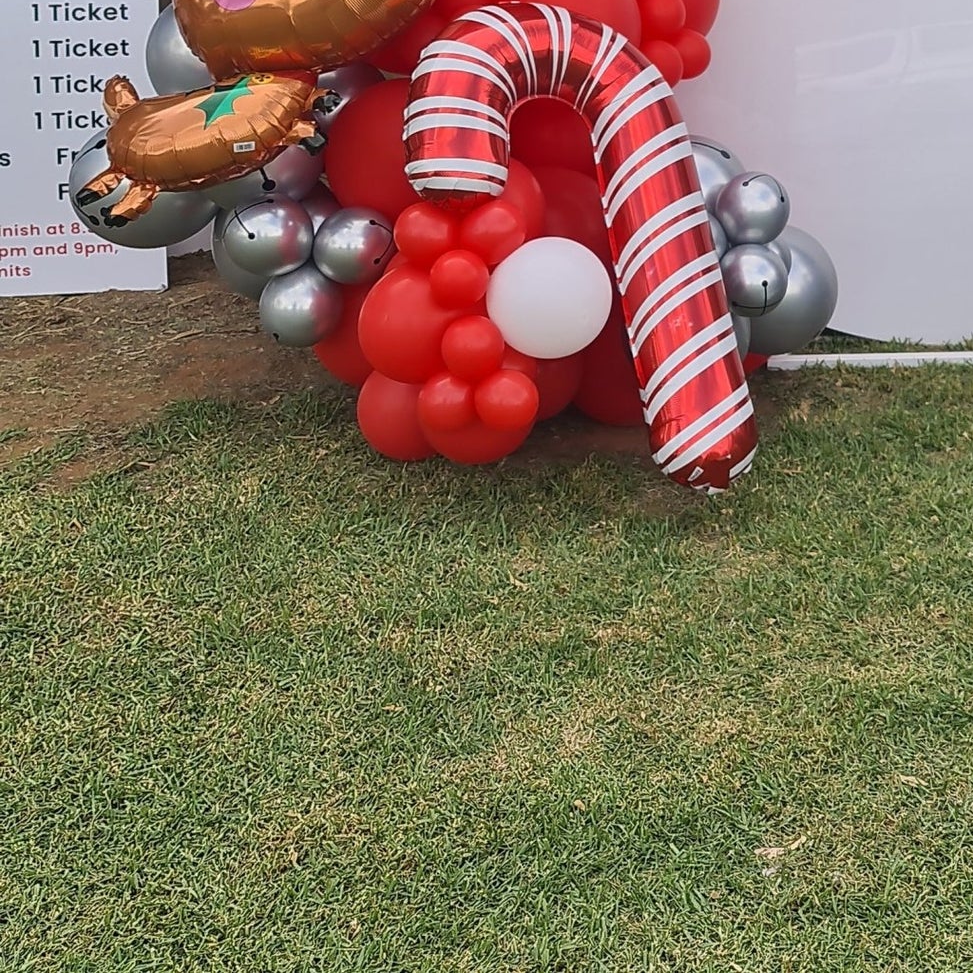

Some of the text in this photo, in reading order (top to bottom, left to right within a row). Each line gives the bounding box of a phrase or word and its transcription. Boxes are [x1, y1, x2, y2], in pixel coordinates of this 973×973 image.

[31, 2, 129, 22] 1 Ticket
[32, 38, 130, 58] 1 Ticket
[33, 74, 130, 94] 1 Tick
[34, 110, 111, 130] 1 Tick
[0, 224, 40, 238] nish
[46, 223, 65, 235] at
[33, 242, 68, 256] and
[74, 242, 118, 258] 9pm,
